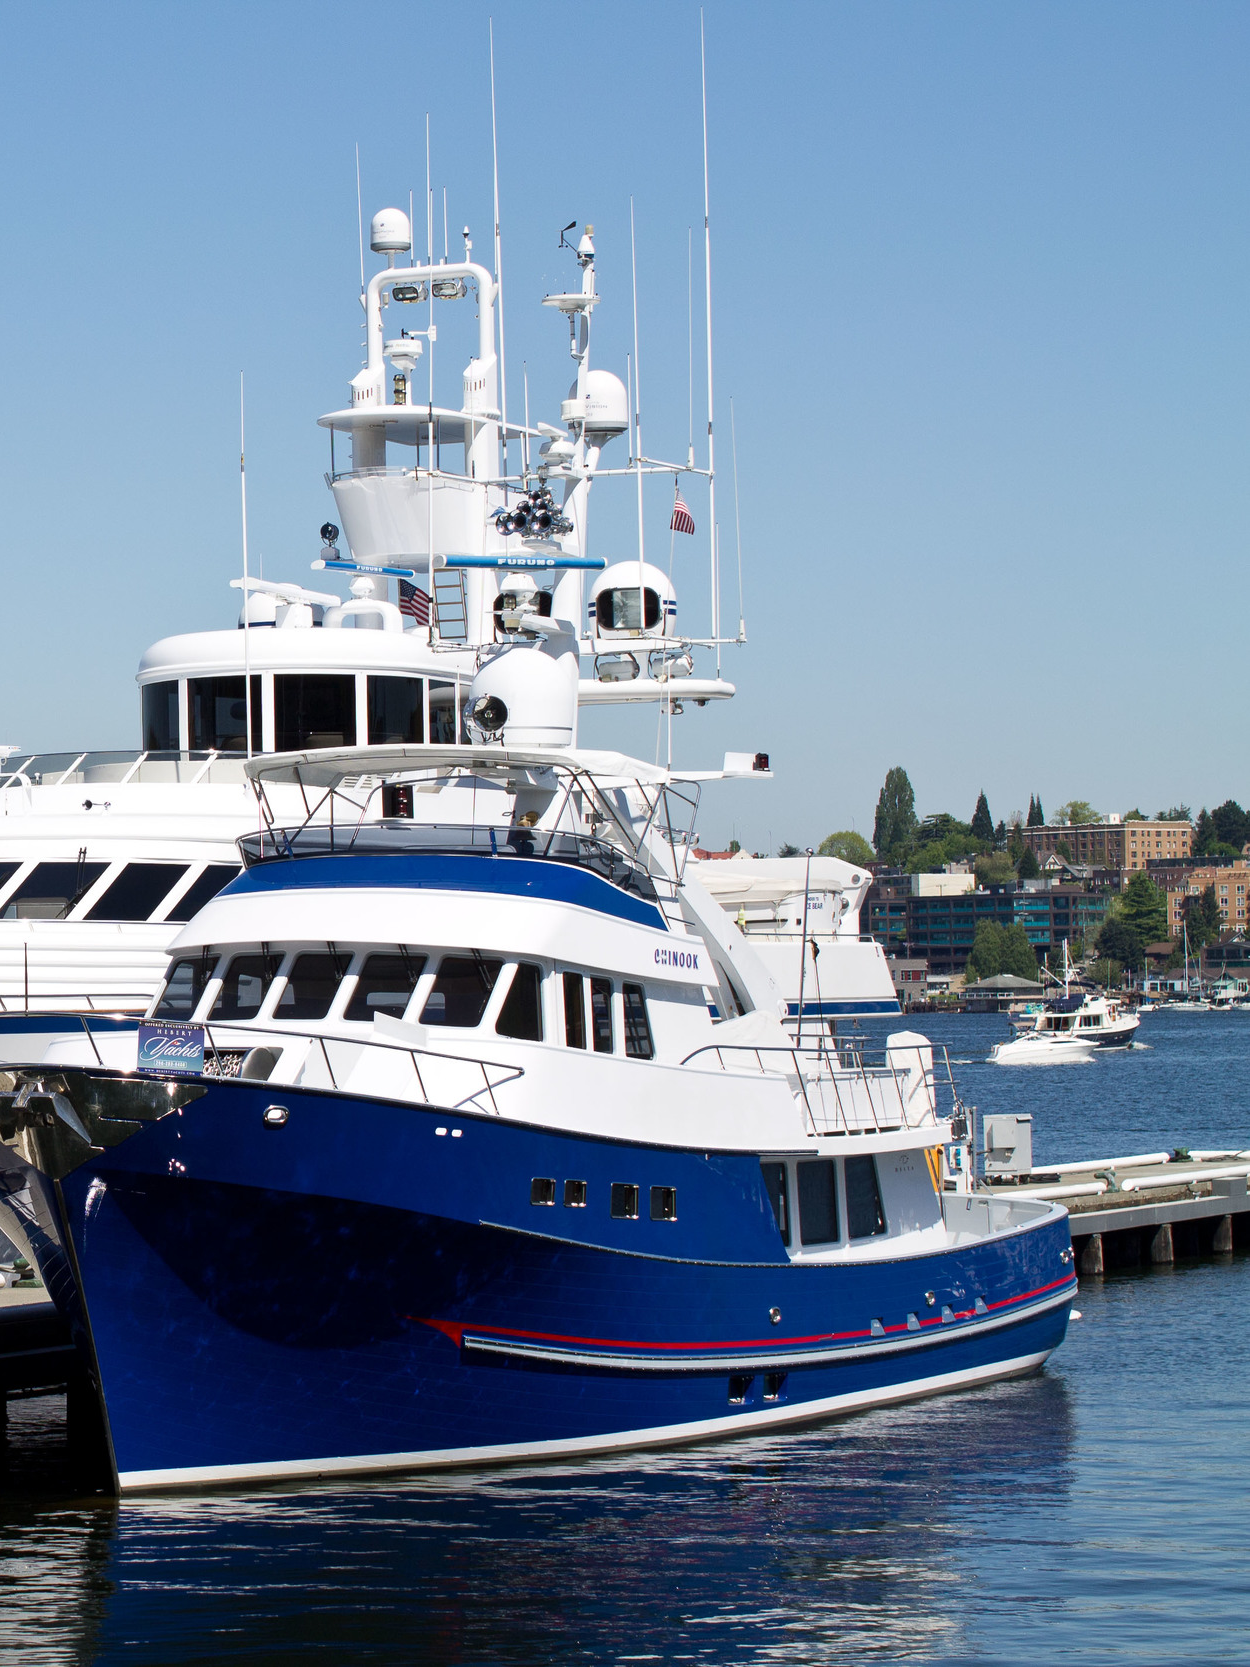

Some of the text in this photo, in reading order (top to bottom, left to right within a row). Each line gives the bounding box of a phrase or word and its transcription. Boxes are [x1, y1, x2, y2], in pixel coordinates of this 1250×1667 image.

[497, 558, 555, 566] FURUNO
[654, 948, 699, 969] CHINOOK
[139, 1036, 202, 1061] Yachts
